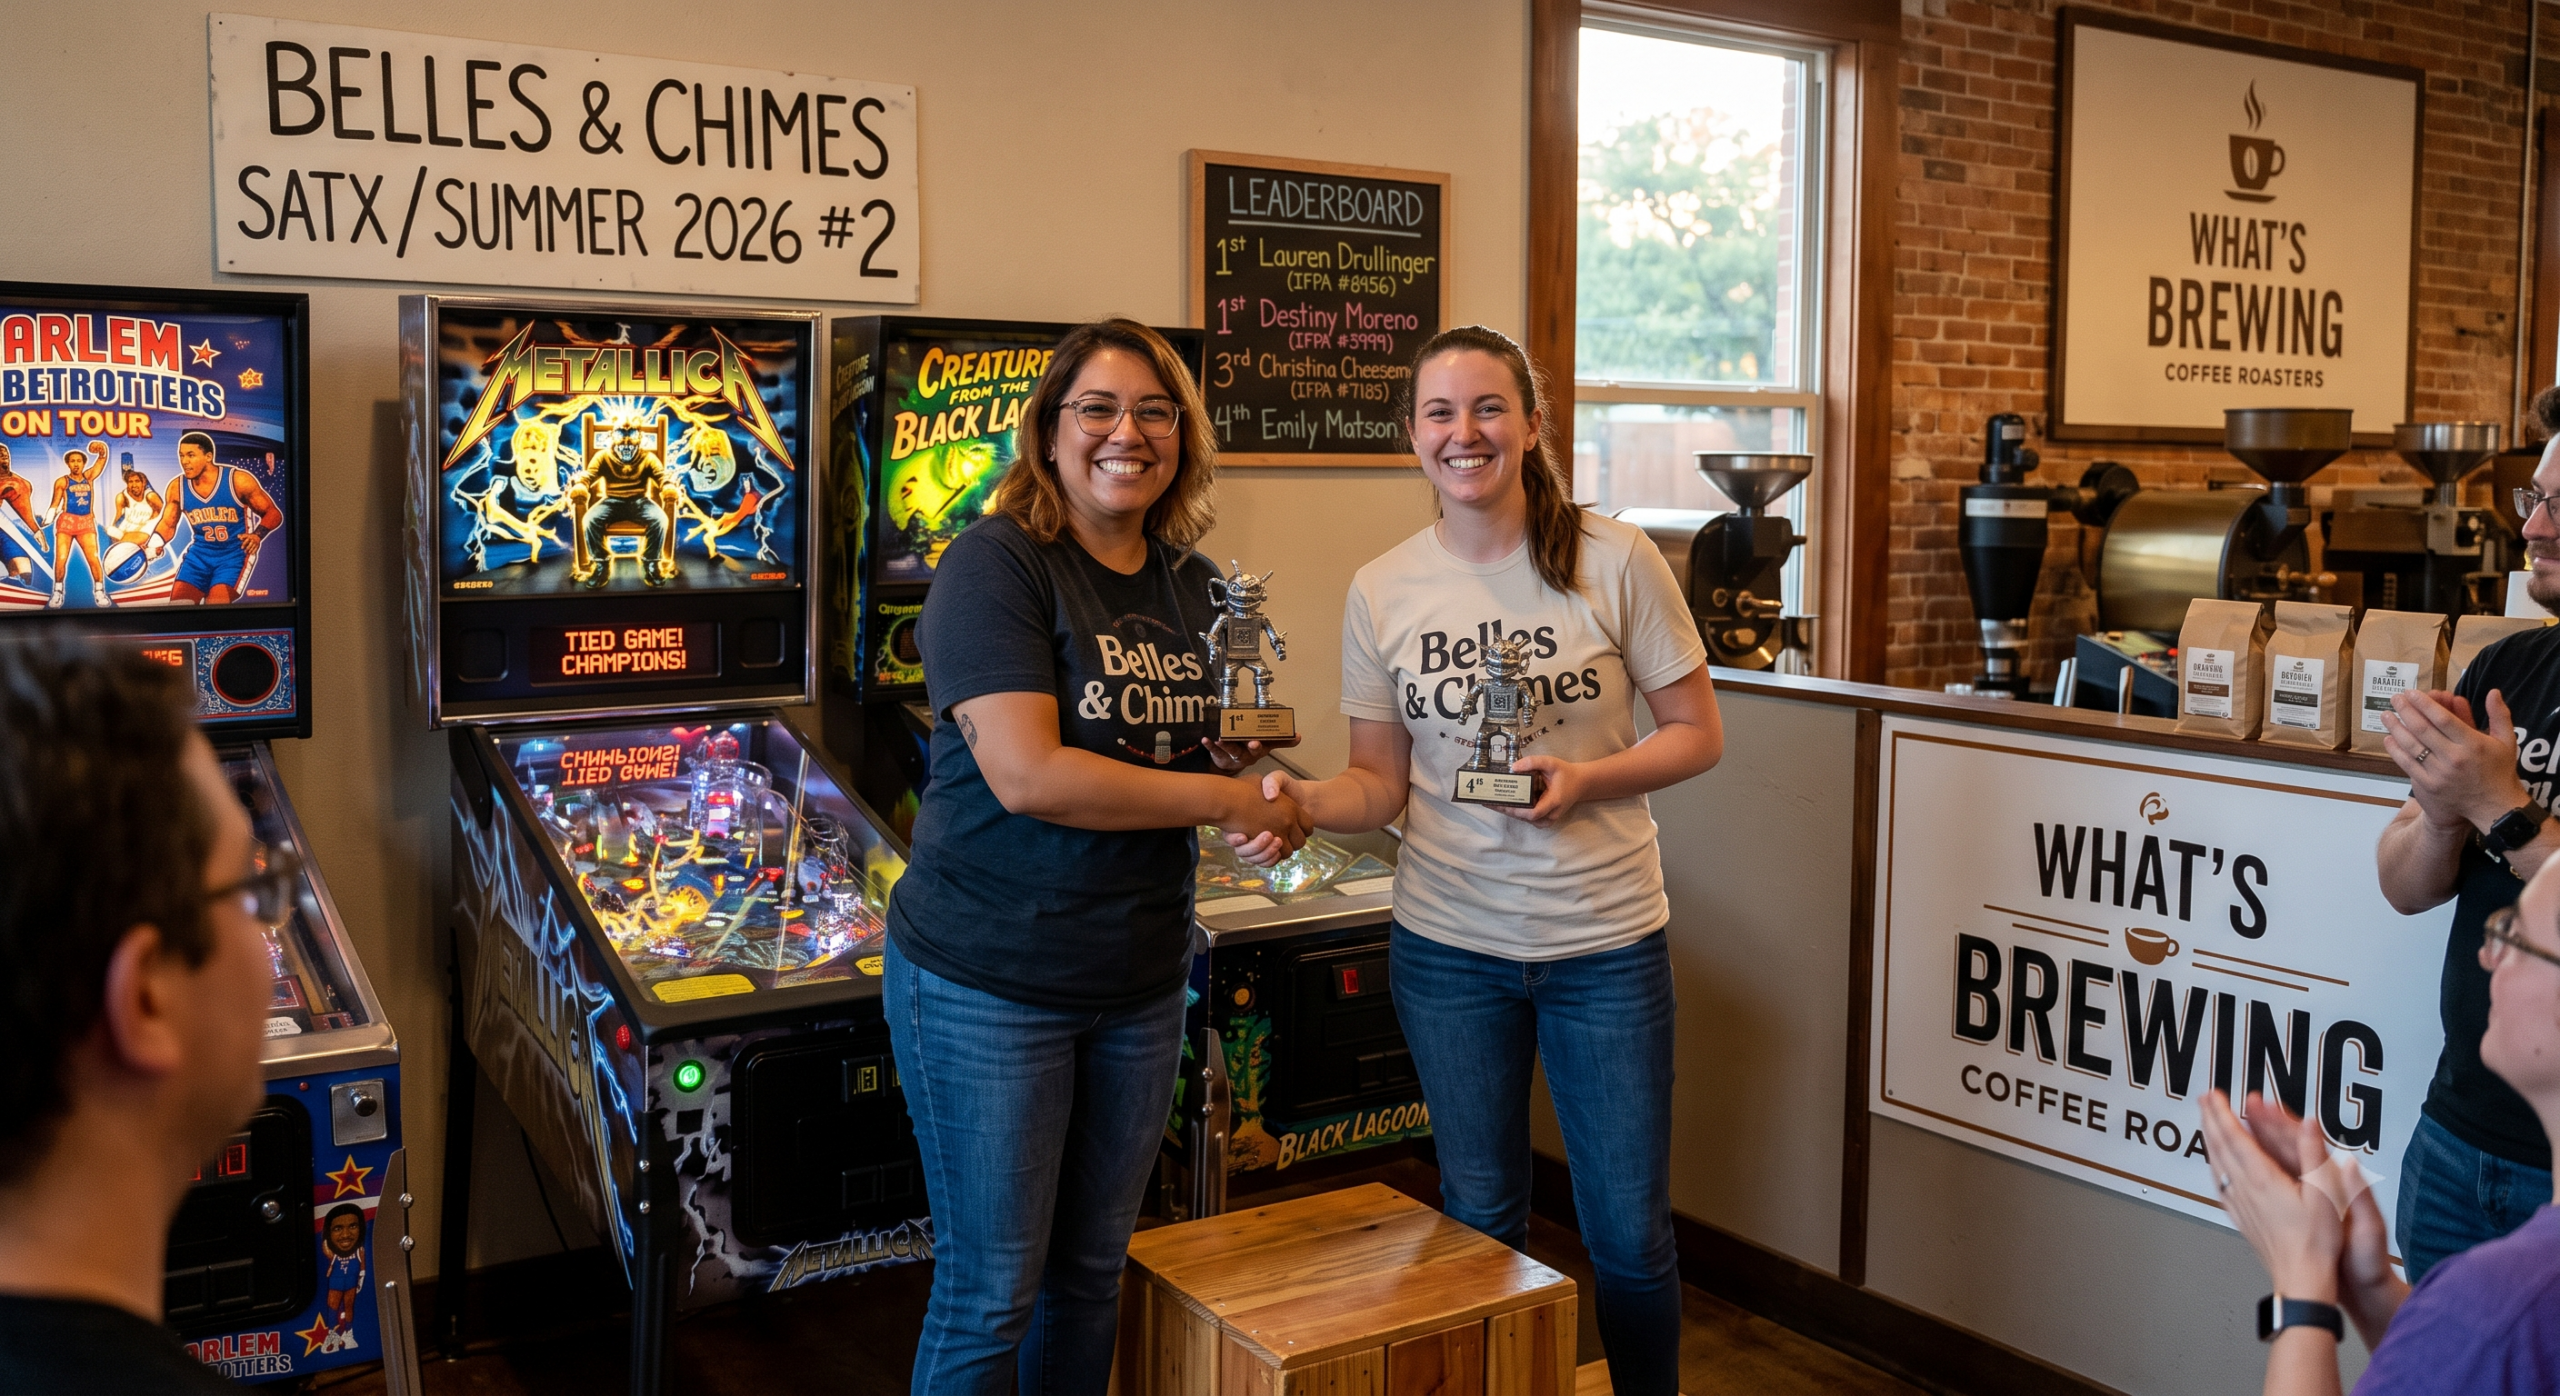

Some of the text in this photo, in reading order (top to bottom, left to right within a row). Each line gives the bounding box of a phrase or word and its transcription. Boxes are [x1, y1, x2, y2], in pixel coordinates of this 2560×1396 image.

[265, 40, 890, 181] BELLES & CHIMES
[237, 164, 899, 279] SATX/SUMMER 2026 #2
[1229, 176, 1424, 227] LEADERBOARD
[1215, 235, 1435, 285] 1st Lauren Drullinger
[2190, 212, 2307, 275] WHAT'S
[1287, 270, 1396, 298] (IFPA #8956)
[1217, 295, 1418, 337] 1st Destiny Moreno
[2148, 275, 2344, 359] BREWING
[1, 314, 182, 374] ARLEM
[1289, 330, 1332, 351] (IFPA
[1214, 348, 1250, 388] 3rd
[1259, 353, 1337, 379] Christina
[1291, 381, 1390, 403] (IFPA #7185)
[2165, 362, 2324, 388] COFFEE ROASTERS
[442, 319, 795, 471] METALLICA
[949, 381, 1030, 406] FROM THE
[2, 409, 152, 437] ON TOUR
[890, 405, 984, 460] BLACK
[1214, 404, 1399, 450] 4th Emily Matson
[562, 650, 687, 675] CHAMPIONS!
[565, 628, 684, 652] TIED GAME!
[1095, 635, 1203, 681] Belles
[1078, 680, 1112, 720] &
[1406, 668, 1602, 720] & Cmes
[1229, 714, 1244, 731] 1st
[2034, 822, 2268, 940] WHAT'S
[1952, 932, 2384, 1155] BREWING
[1960, 1064, 2108, 1133] COFFEE
[1276, 1101, 1430, 1171] BLACK LAGOON
[769, 1218, 935, 1293] METALLICA
[208, 1354, 291, 1379] OTTERS
